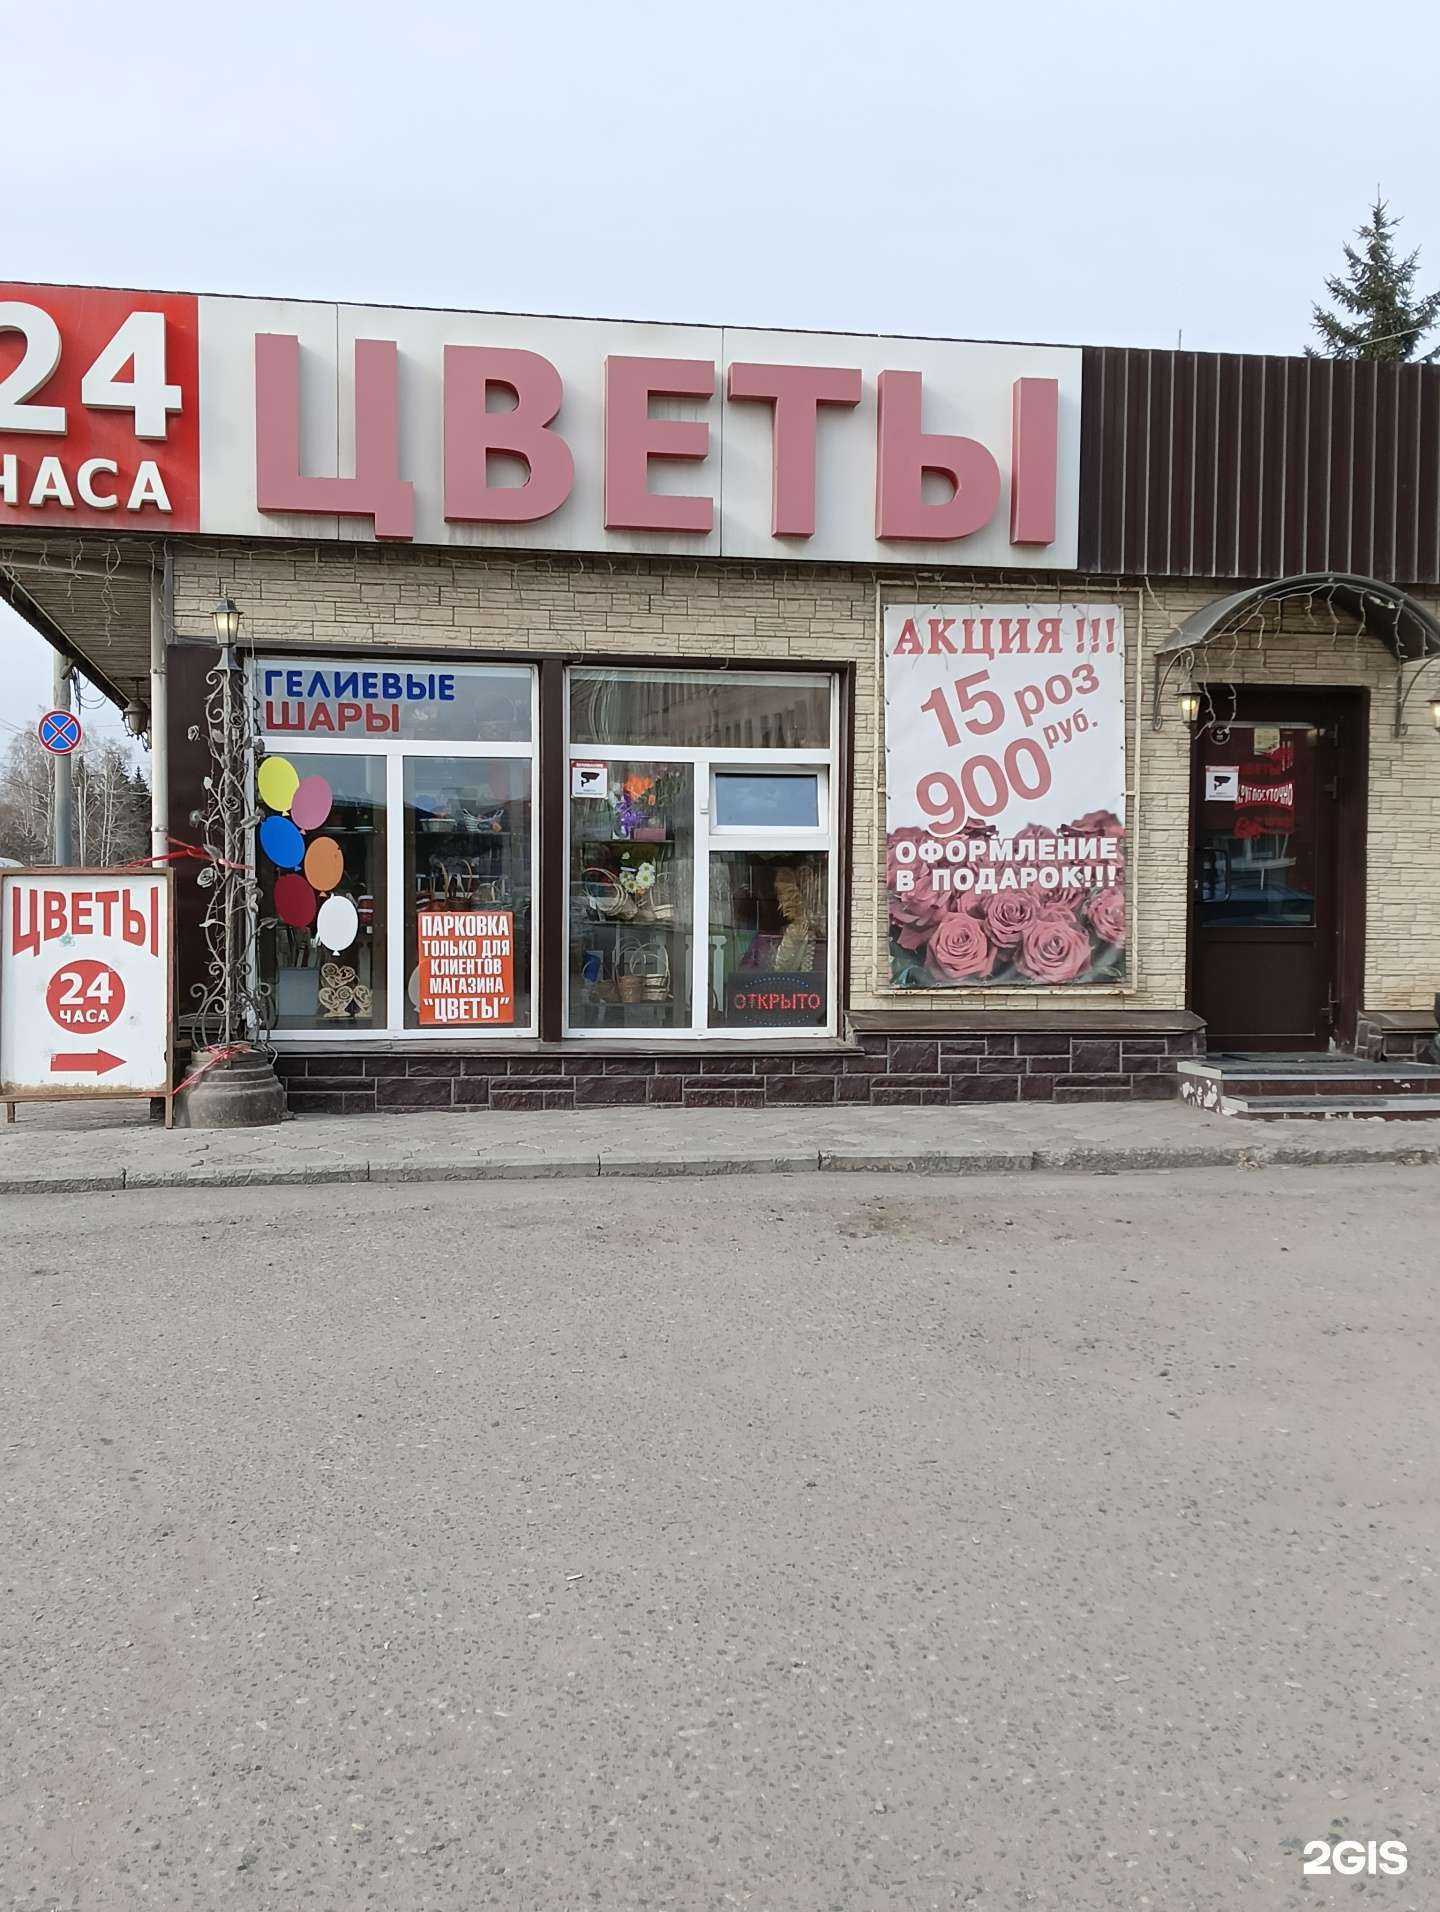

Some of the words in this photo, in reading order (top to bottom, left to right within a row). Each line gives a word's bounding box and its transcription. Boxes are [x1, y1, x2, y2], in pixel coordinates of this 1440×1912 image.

[0, 301, 182, 440] 24
[255, 332, 1059, 546] ЦВЕТЫ
[893, 617, 1063, 661] АКЦИЯ
[264, 670, 456, 701] ГЕЛИЕВЫЕ
[265, 701, 400, 733] ШАРЫ
[920, 669, 1006, 748] 15
[1014, 663, 1100, 727] роз
[915, 737, 1052, 838] 900
[1042, 707, 1099, 749] руб.
[895, 837, 1118, 864] ОФОРМЛЕНИЕ
[896, 870, 915, 892] В
[932, 865, 1117, 895] ПОДАРОК!!!
[12, 886, 159, 957] ЦВЕТЫ
[421, 915, 509, 937] ПАРКОВКА
[422, 940, 477, 957] ТОЛЬКО
[482, 940, 510, 959] ДЛЯ
[430, 958, 502, 976] КЛИЕНТОВ
[59, 971, 113, 1005] 24
[429, 976, 504, 994] МАГАЗИНА
[59, 1008, 110, 1024] ЧАСА
[735, 993, 821, 1009] ОТКРЫТО
